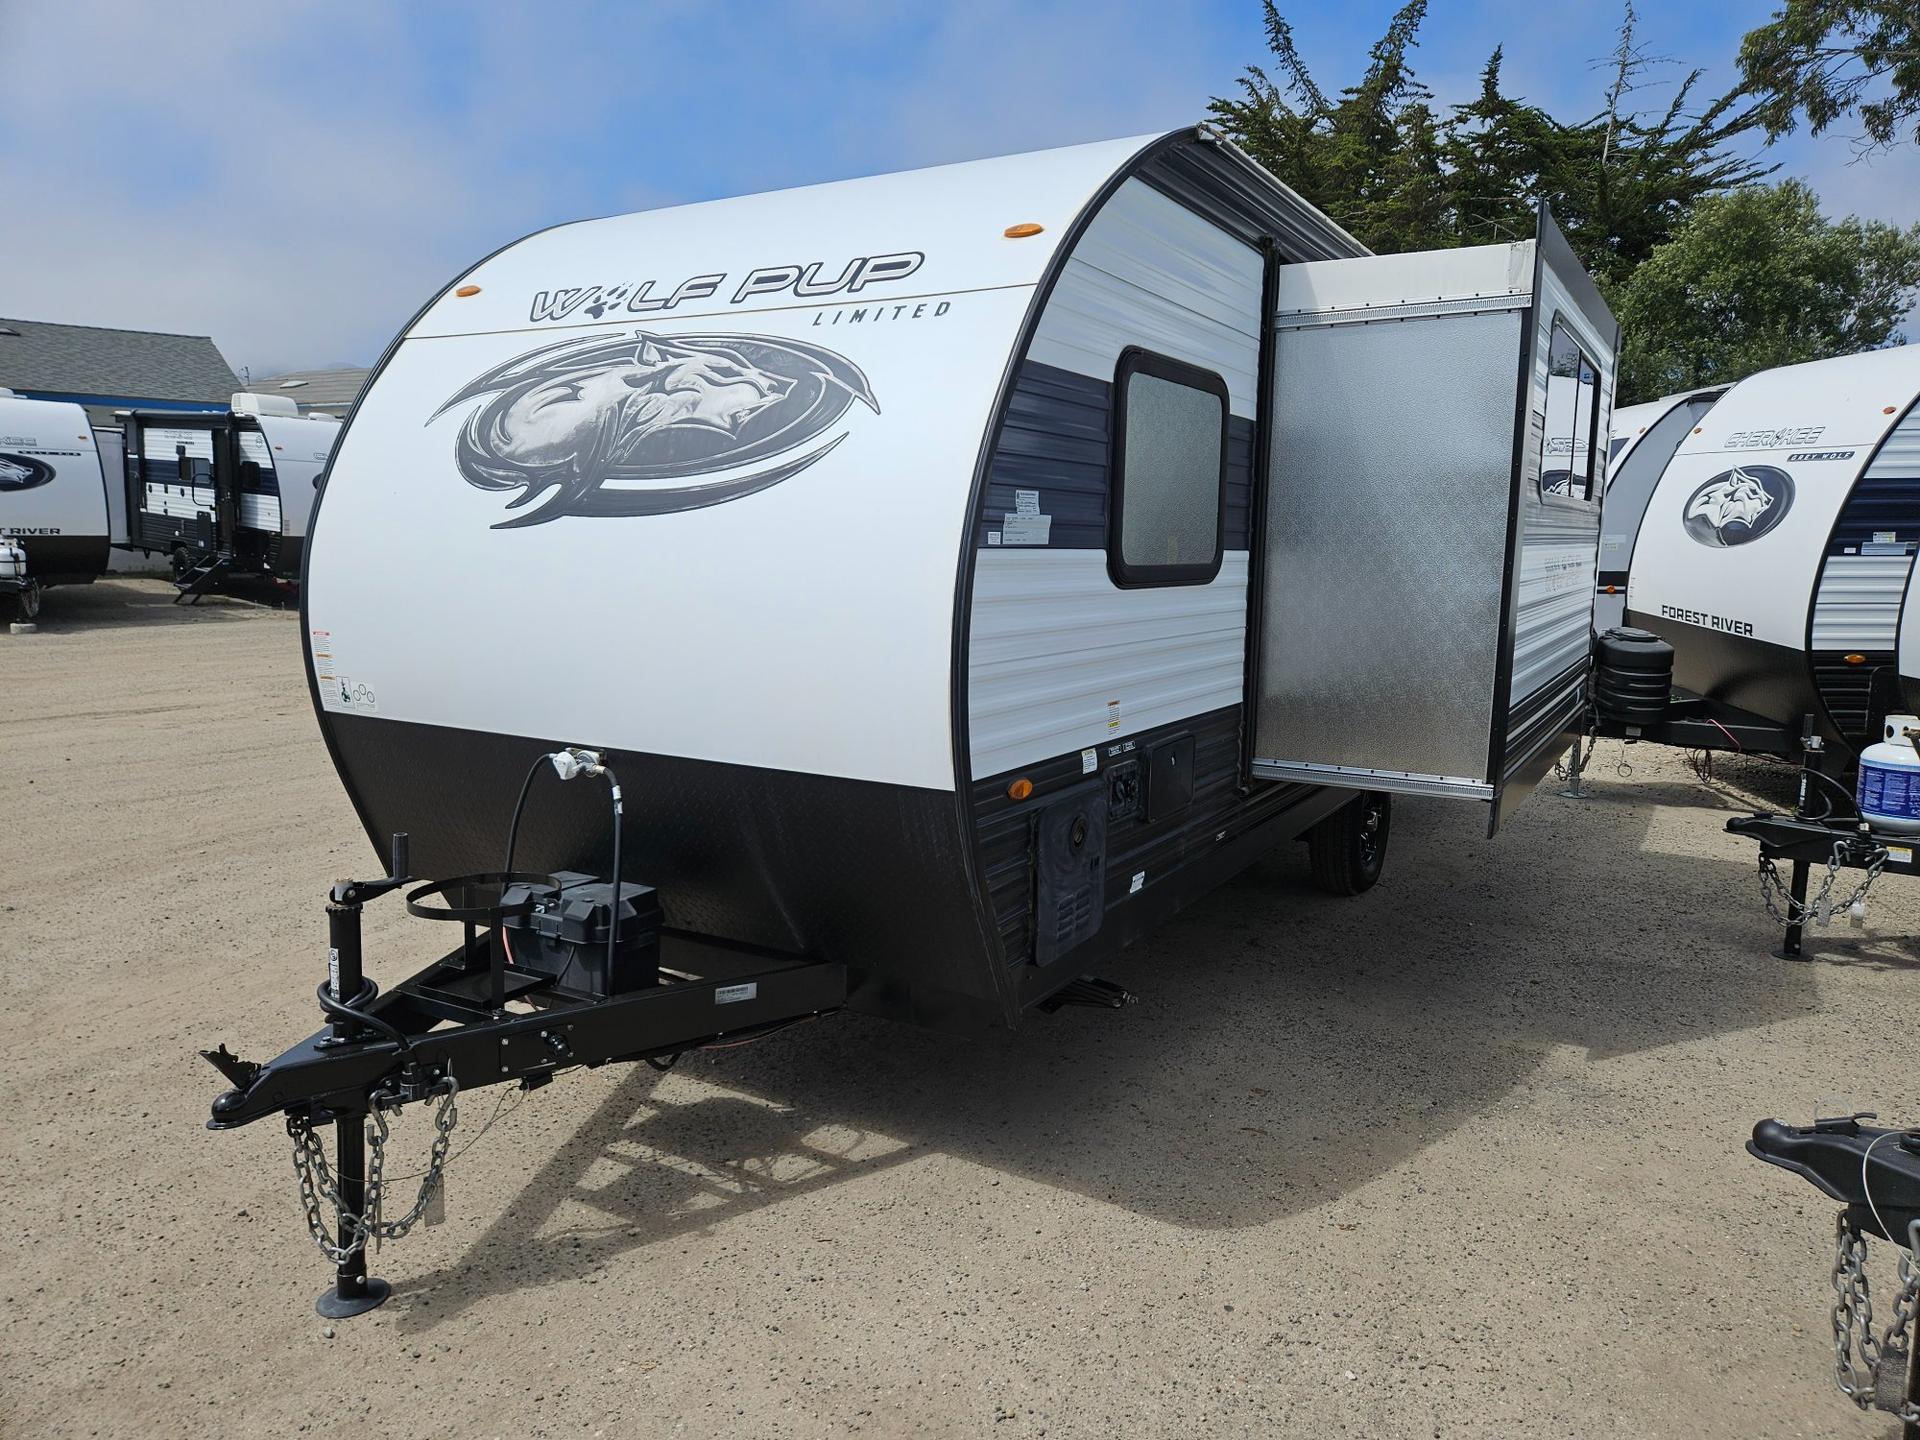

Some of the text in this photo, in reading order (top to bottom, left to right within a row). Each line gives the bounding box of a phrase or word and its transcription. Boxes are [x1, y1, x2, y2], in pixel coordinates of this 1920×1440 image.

[730, 250, 926, 305] PUP
[812, 300, 952, 327] LIMITED
[1790, 451, 1852, 461] GREY WOLF
[9, 527, 61, 535] RIVER
[1661, 604, 1754, 637] FOREST RIVER
